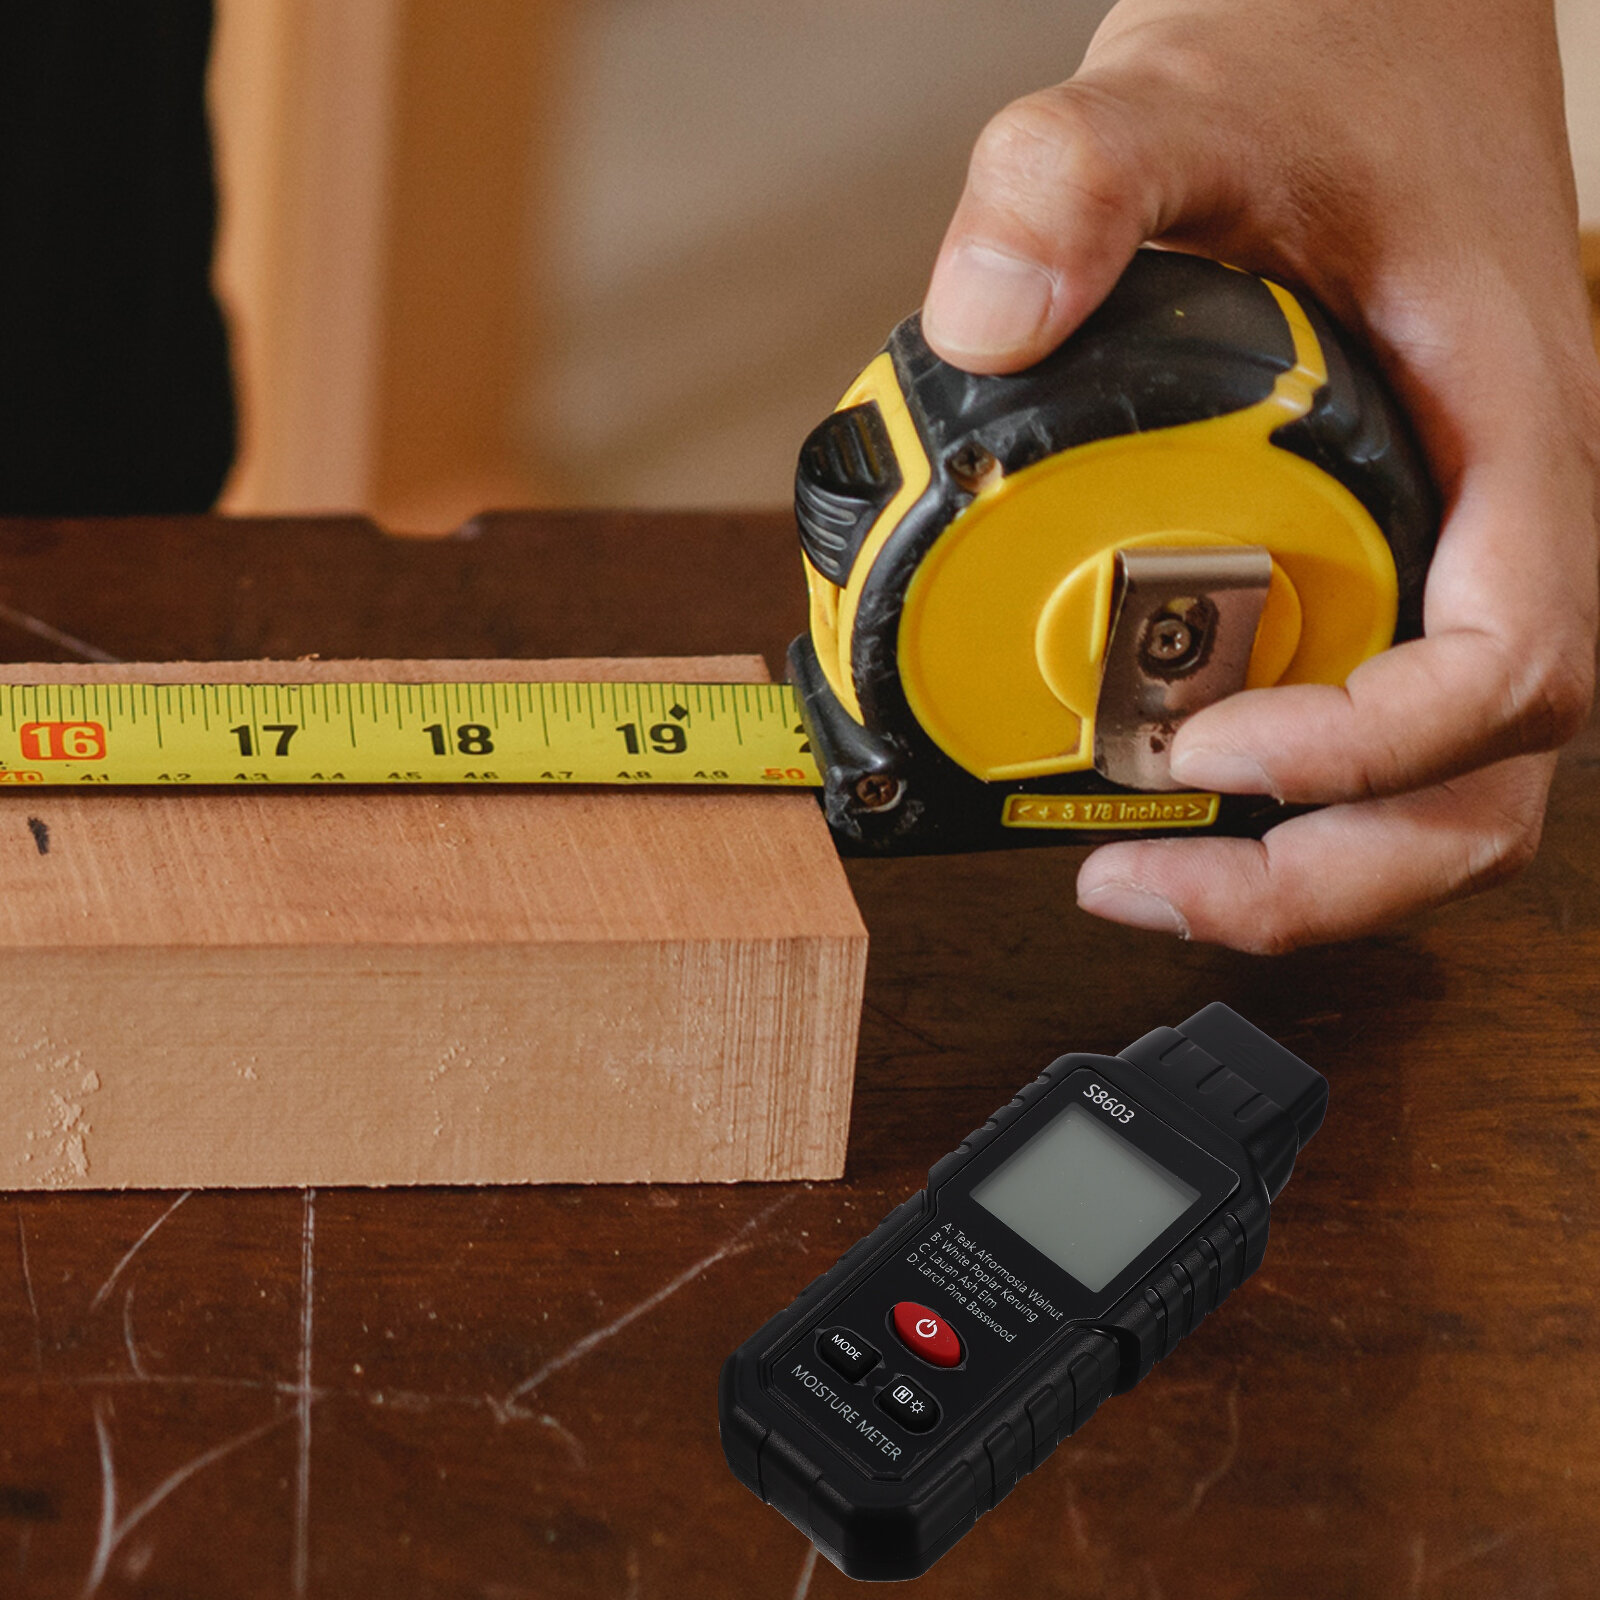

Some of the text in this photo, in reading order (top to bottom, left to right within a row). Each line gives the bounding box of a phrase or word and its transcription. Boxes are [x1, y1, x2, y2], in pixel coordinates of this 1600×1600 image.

[29, 723, 688, 758] 16 17 18 19
[761, 767, 806, 780] 50
[1062, 802, 1075, 821] 3
[1083, 802, 1113, 820] 1/8
[1082, 1083, 1135, 1124] S8603
[929, 1251, 959, 1277] Lauan
[957, 1275, 978, 1294] Ash
[977, 1289, 997, 1309] Elm
[941, 1239, 970, 1267] White
[969, 1263, 1002, 1291] Poplar
[1000, 1288, 1039, 1323] Keruing
[953, 1230, 977, 1253] Teak
[975, 1249, 1028, 1294] Afrormosia
[1028, 1289, 1064, 1321] Walnut
[918, 1261, 946, 1287] Larch
[944, 1283, 967, 1305] Pine
[966, 1300, 1018, 1343] Basswood
[831, 1334, 863, 1361] MODE
[790, 1364, 903, 1461] MOISTURE METER
